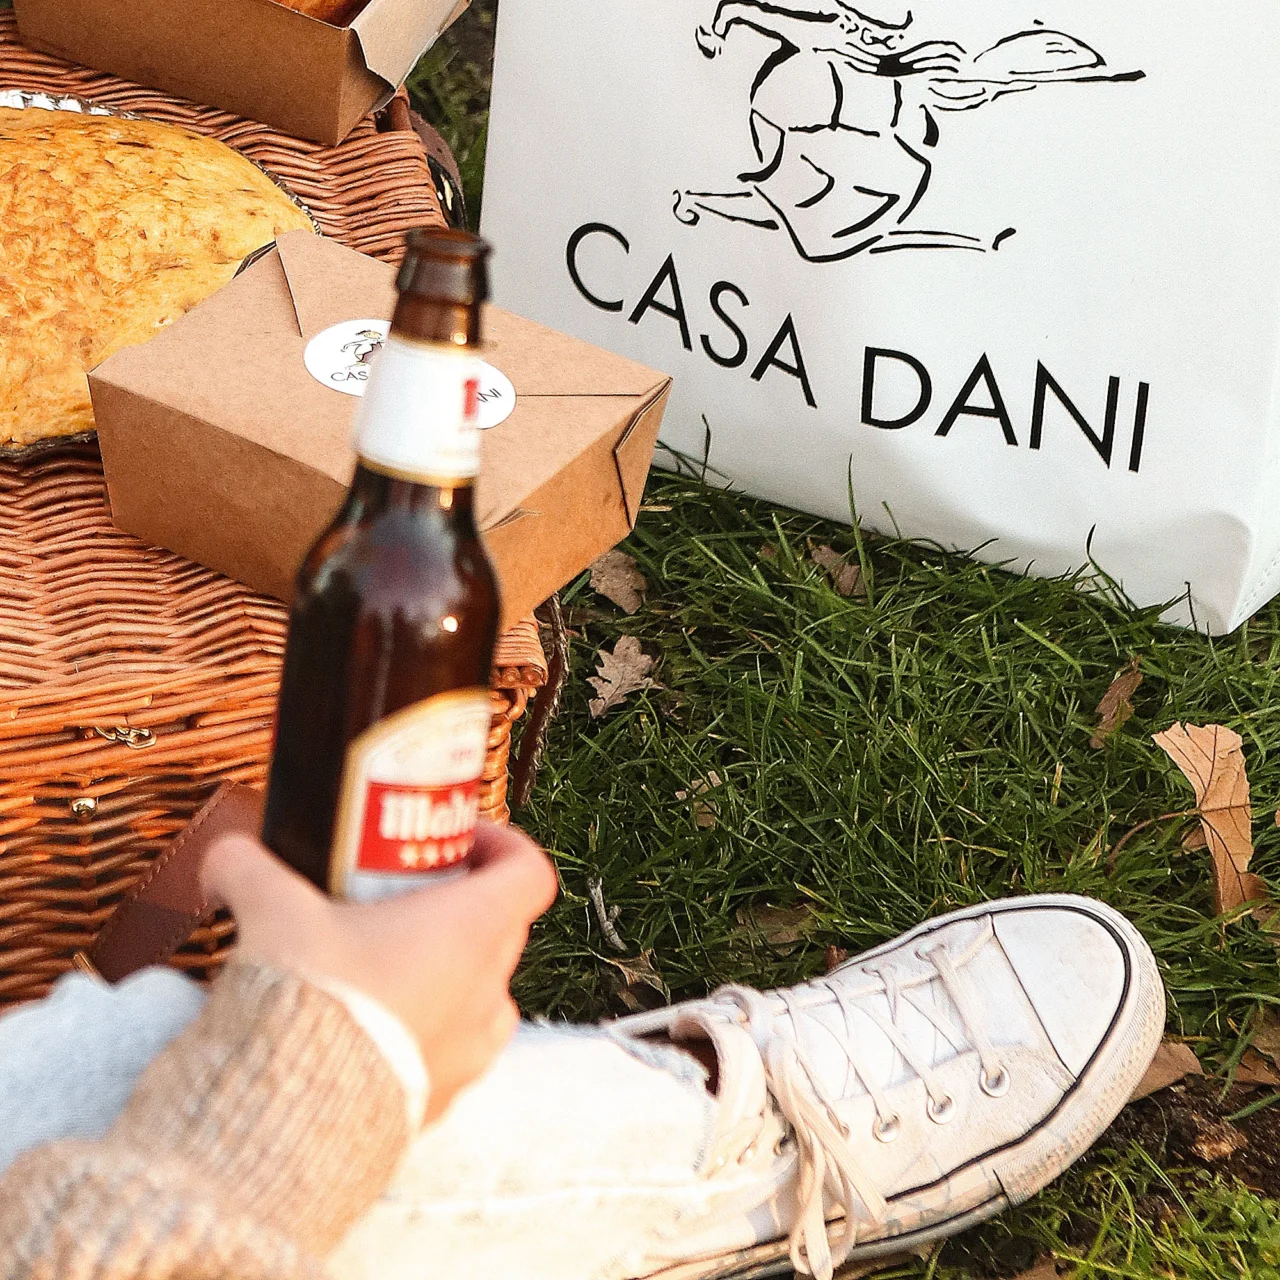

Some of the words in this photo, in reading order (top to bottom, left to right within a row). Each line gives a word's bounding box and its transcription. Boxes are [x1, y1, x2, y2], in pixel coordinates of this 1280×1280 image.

[330, 370, 369, 382] CAS
[566, 222, 818, 409] CASA
[859, 345, 1151, 473] DANI
